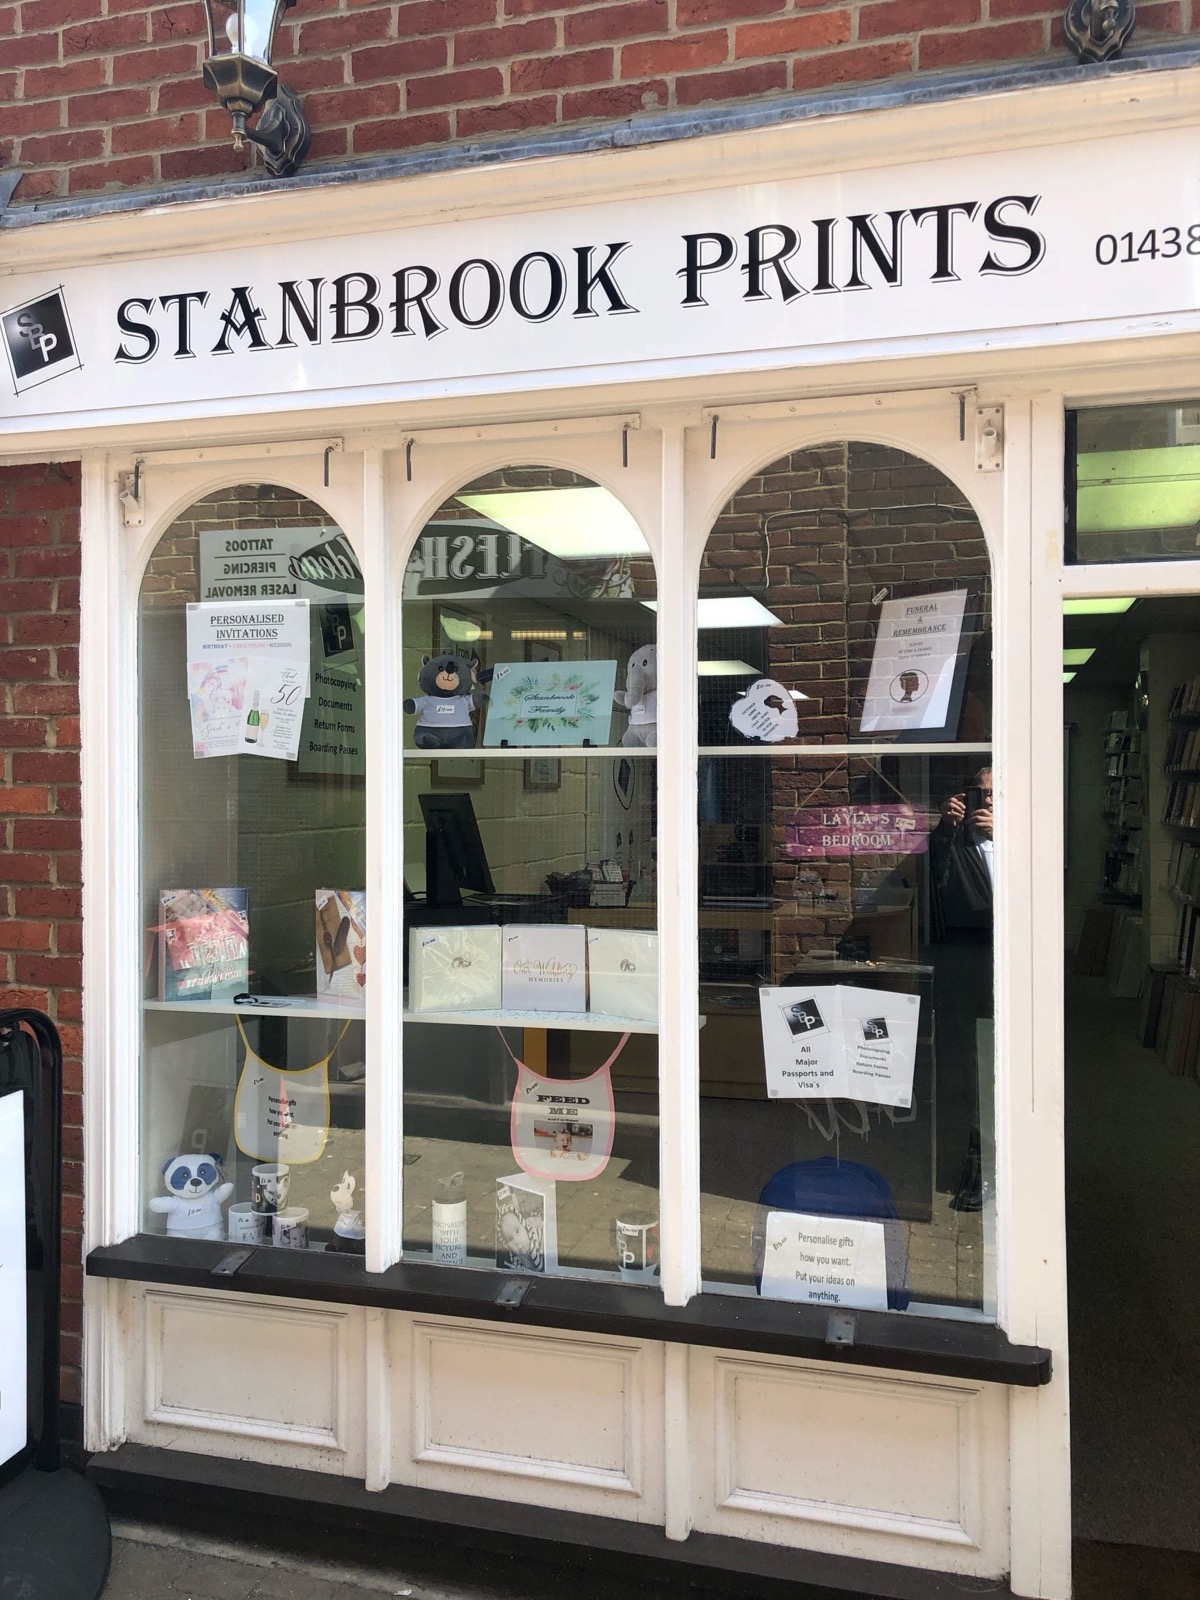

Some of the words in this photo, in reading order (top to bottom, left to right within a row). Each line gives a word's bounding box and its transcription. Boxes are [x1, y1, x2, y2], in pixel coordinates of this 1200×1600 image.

[114, 241, 641, 364] STANBROOK
[676, 194, 1046, 308] PRINTS
[906, 604, 938, 614] FUNERAL
[210, 614, 284, 625] PERSONALISED
[216, 628, 278, 639] INVITATIONS
[893, 624, 947, 637] REMEMBRANCE
[315, 673, 357, 692] Photocopying
[271, 684, 302, 705] 50
[524, 692, 575, 702] Stanbrook
[318, 696, 353, 711] Documents
[528, 705, 566, 715] Family
[314, 719, 336, 731] Return
[337, 722, 355, 733] Forms
[309, 742, 338, 756] Boarding
[339, 744, 358, 755] Passes
[822, 834, 891, 846] BEDROOM
[795, 1058, 818, 1067] Major
[782, 1070, 818, 1079] Passports
[536, 1095, 590, 1104] FEED
[548, 1107, 578, 1116] ME
[798, 1232, 837, 1247] Personalise
[838, 1237, 854, 1248] gifts
[800, 1252, 816, 1263] how
[816, 1255, 830, 1265] you
[831, 1254, 851, 1266] want.
[795, 1271, 807, 1281] Put
[808, 1275, 824, 1284] your
[826, 1275, 844, 1285] ideas
[808, 1290, 840, 1302] anything.
